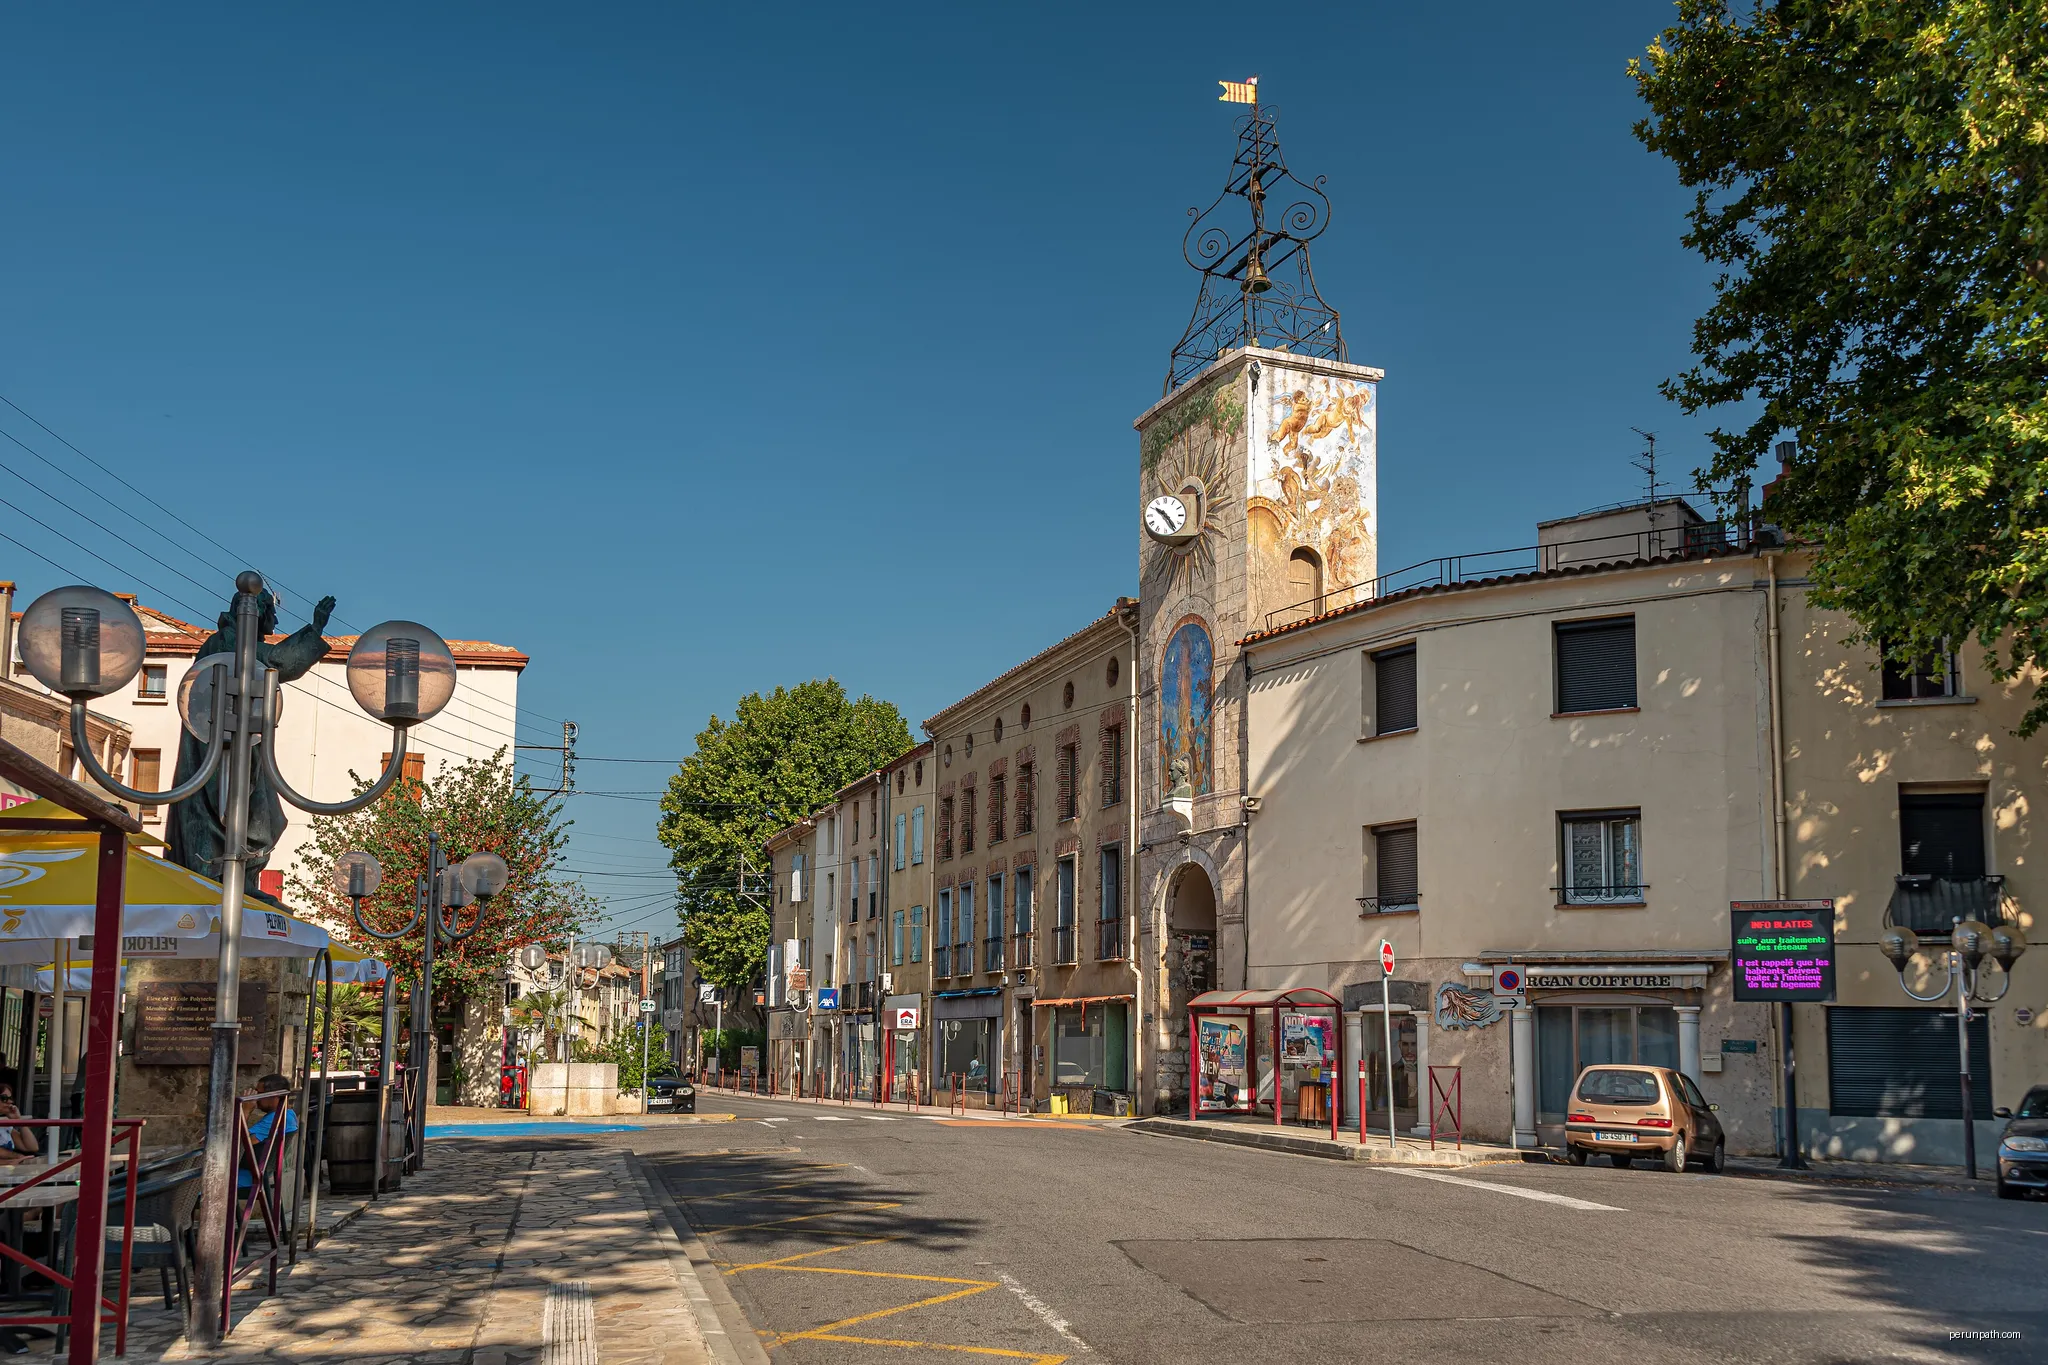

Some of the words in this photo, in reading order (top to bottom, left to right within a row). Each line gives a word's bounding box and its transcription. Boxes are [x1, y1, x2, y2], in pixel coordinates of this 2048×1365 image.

[1774, 920, 1813, 928] BLATTES
[1762, 959, 1794, 967] rappelé
[1578, 975, 1671, 987] COIFFURE
[1780, 981, 1820, 989] logement
[818, 998, 834, 1006] AXA
[1200, 1060, 1219, 1075] BIEN
